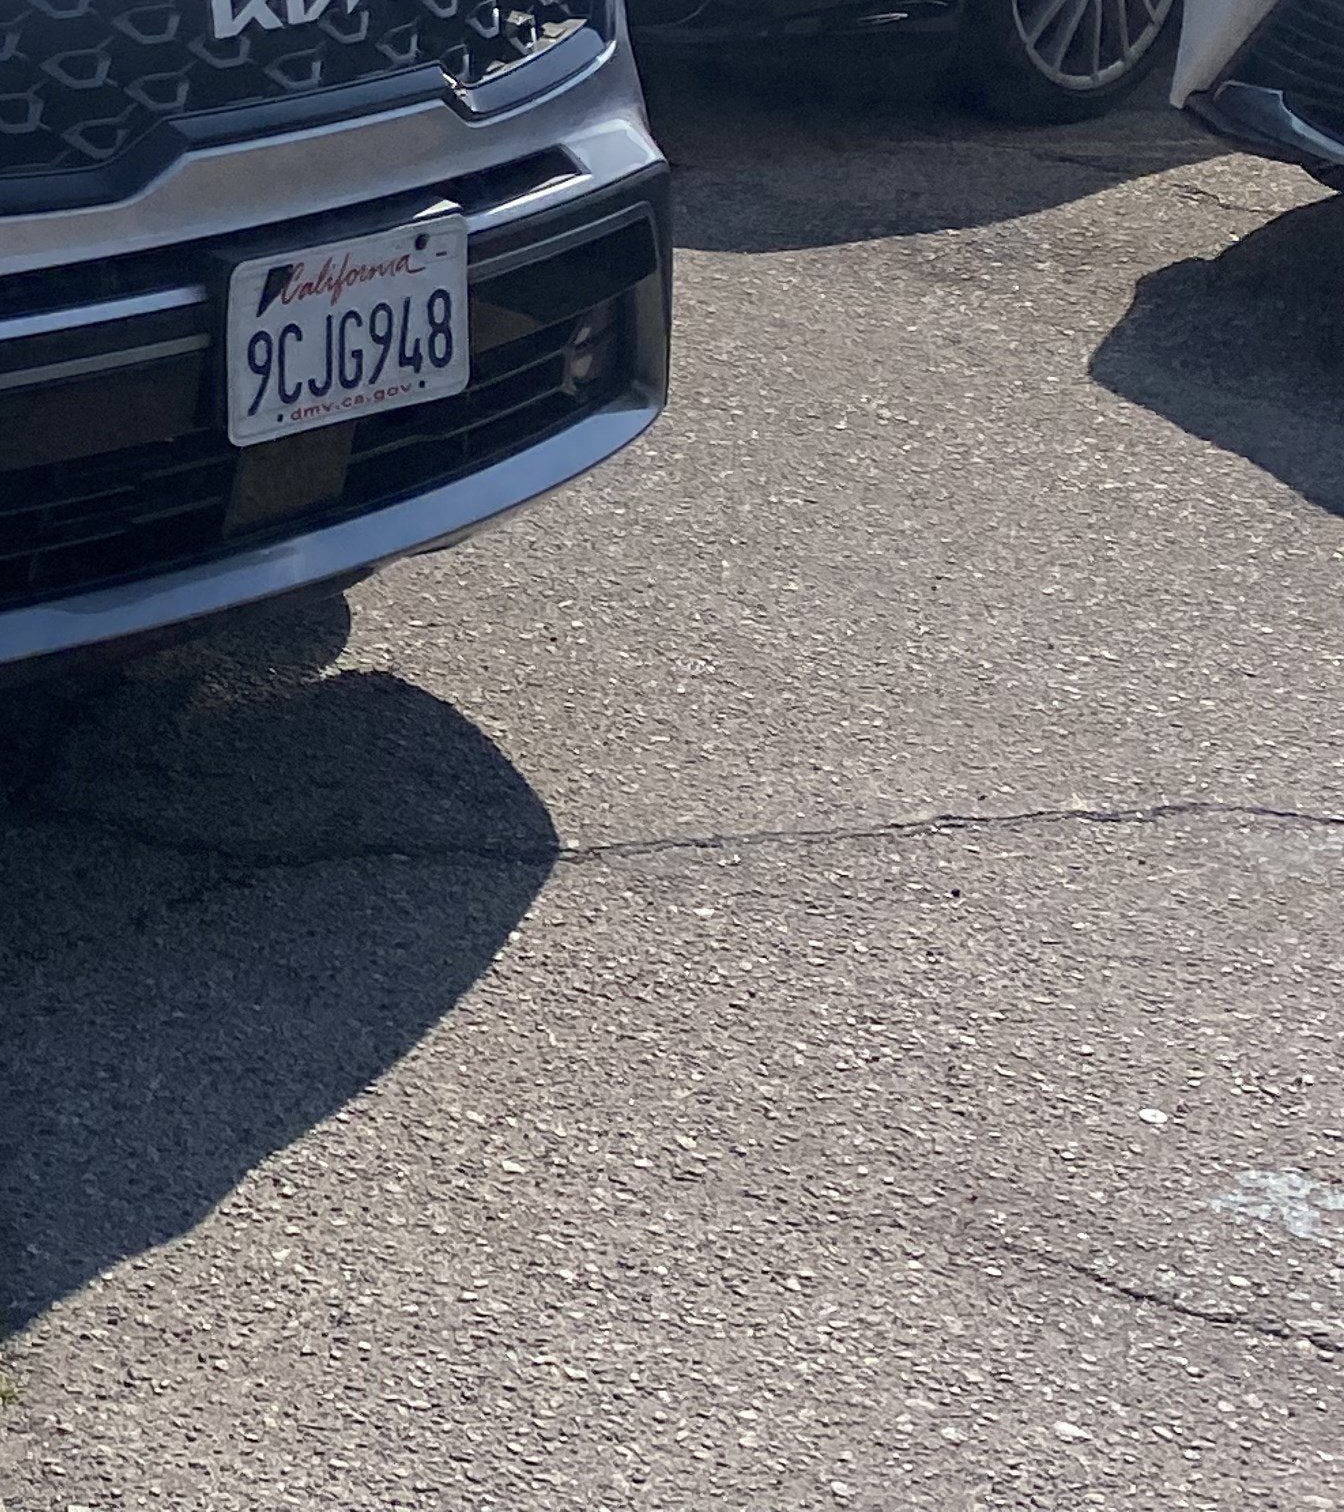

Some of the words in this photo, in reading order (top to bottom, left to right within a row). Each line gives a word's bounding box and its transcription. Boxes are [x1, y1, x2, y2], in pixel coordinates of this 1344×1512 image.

[281, 253, 426, 306] California
[247, 289, 453, 417] 9CJG948
[290, 383, 412, 421] dmv.ca.gov
